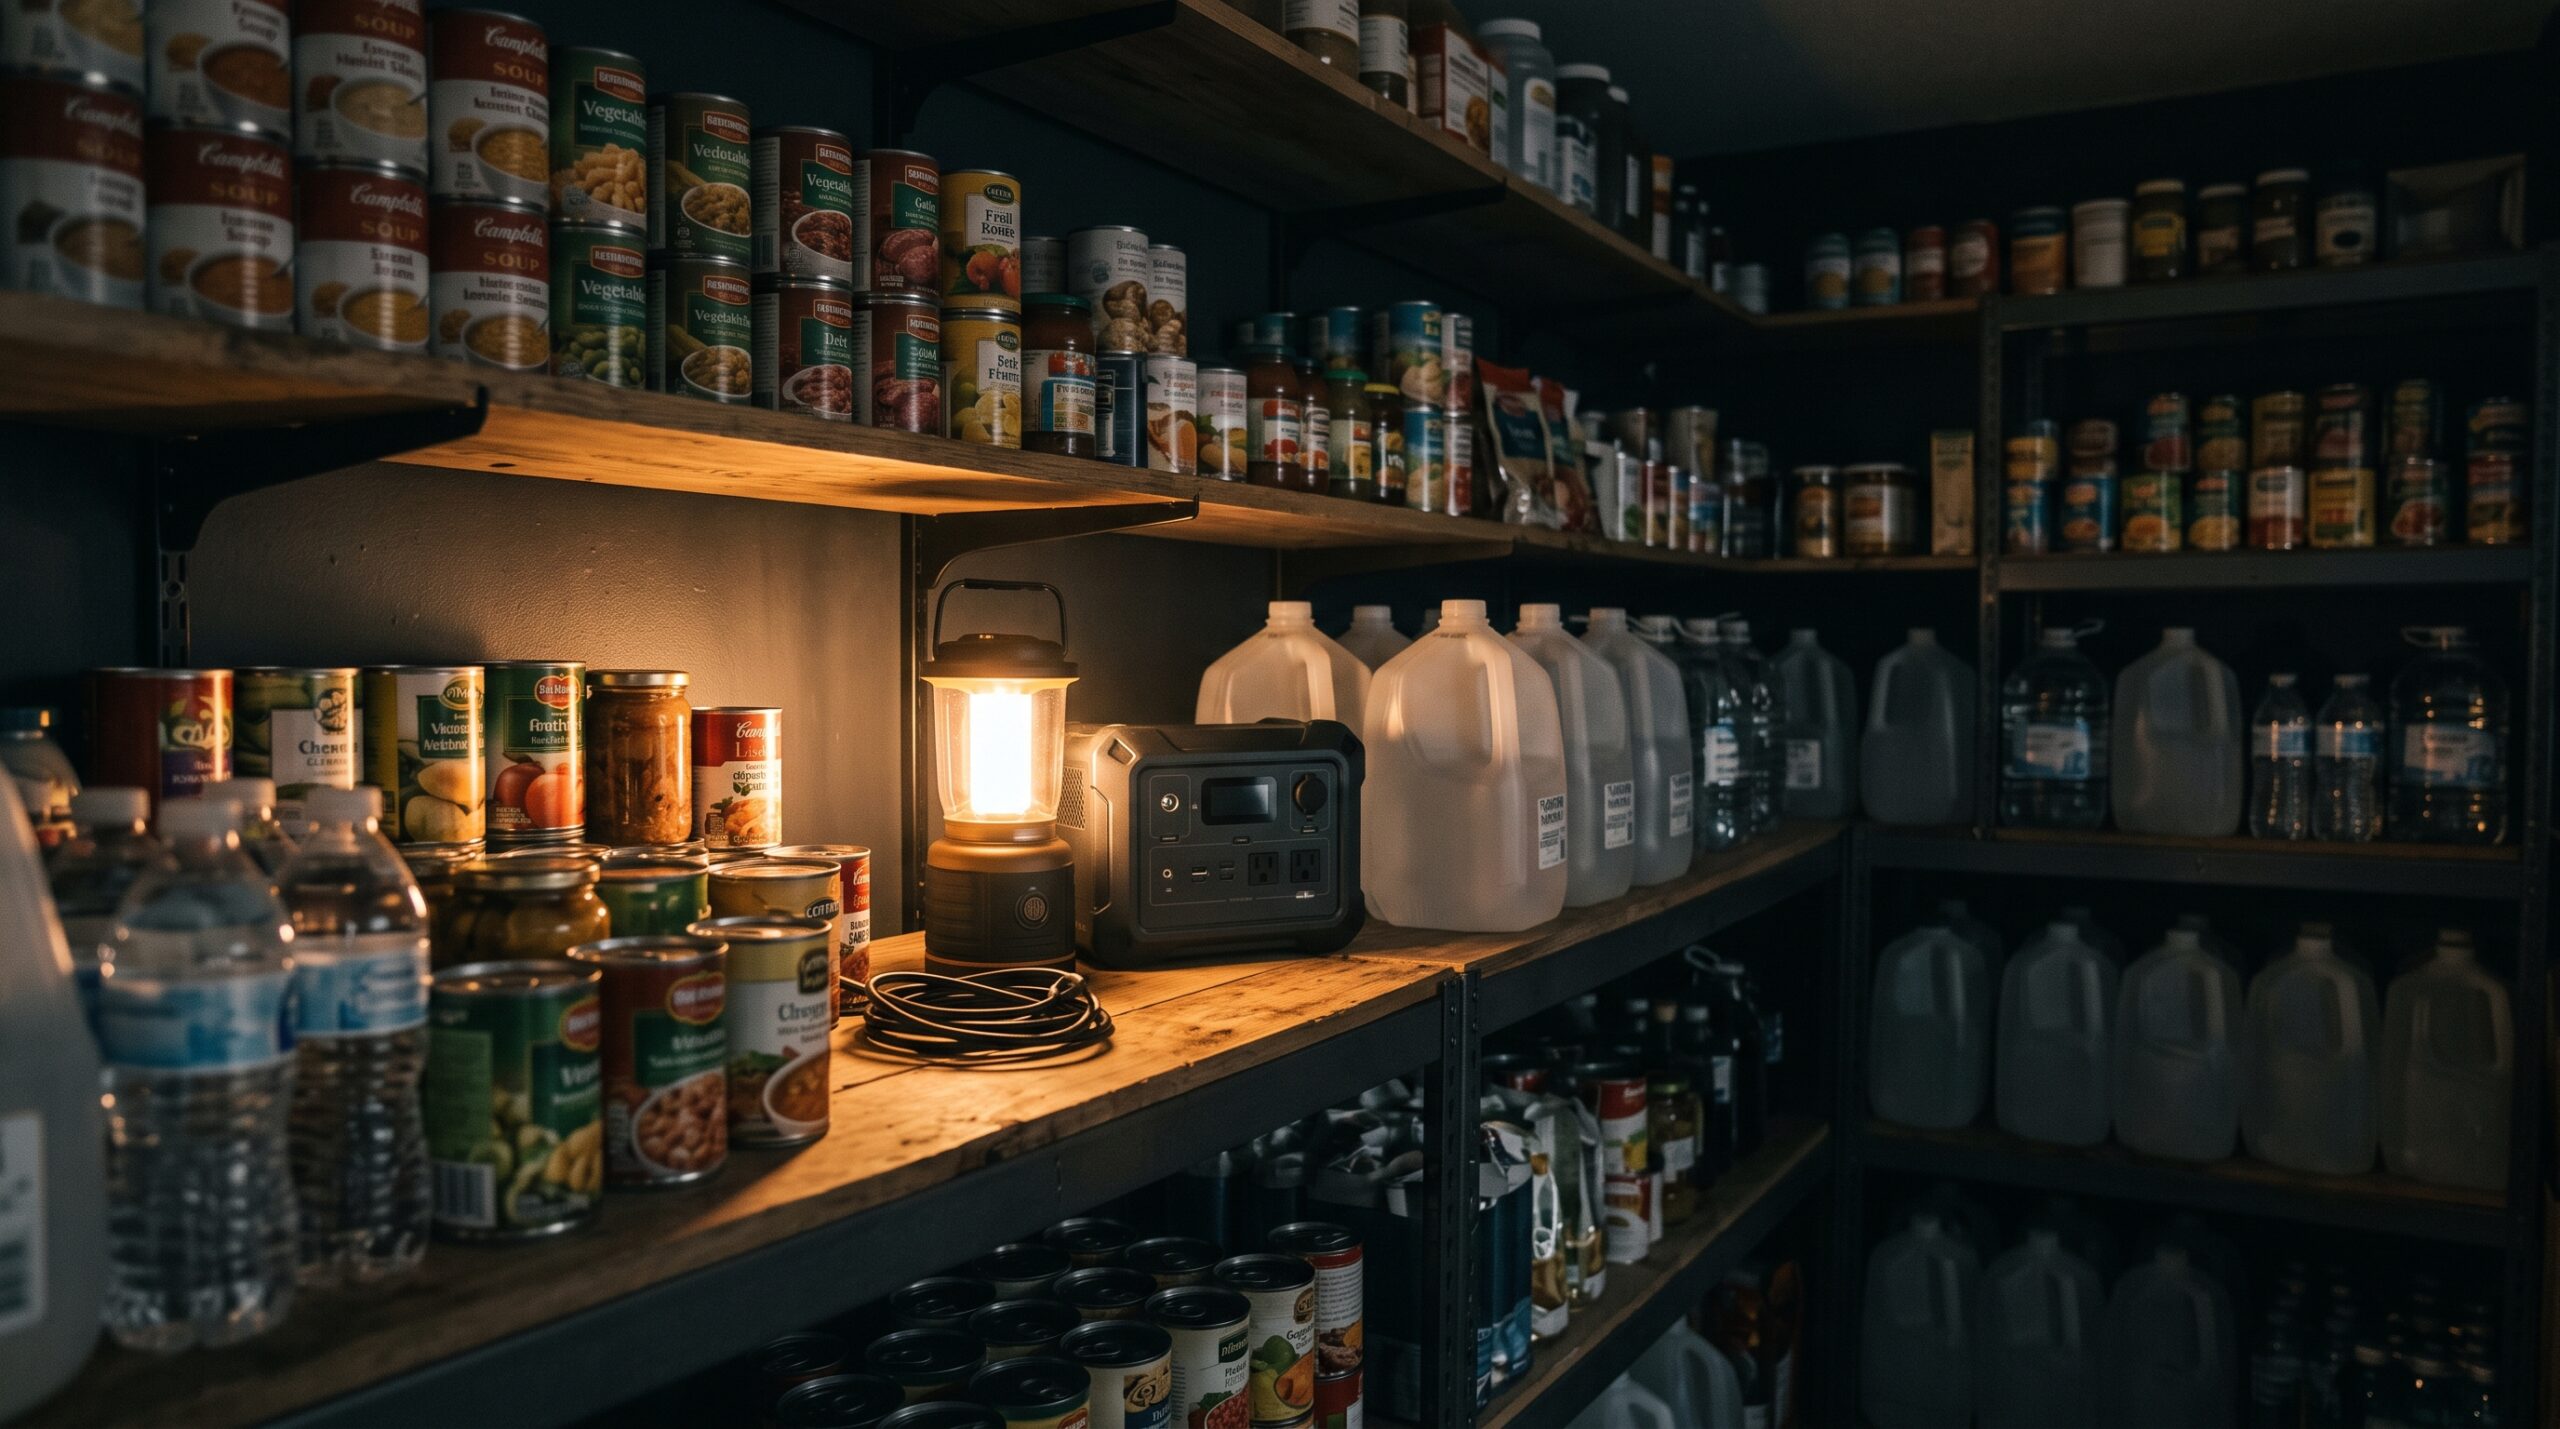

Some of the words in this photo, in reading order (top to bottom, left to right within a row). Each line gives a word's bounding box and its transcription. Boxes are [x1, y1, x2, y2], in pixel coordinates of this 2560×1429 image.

[354, 14, 416, 39] SOUP
[492, 61, 544, 87] SOUP
[360, 220, 420, 242] SOUP
[482, 250, 540, 272] SOUP
